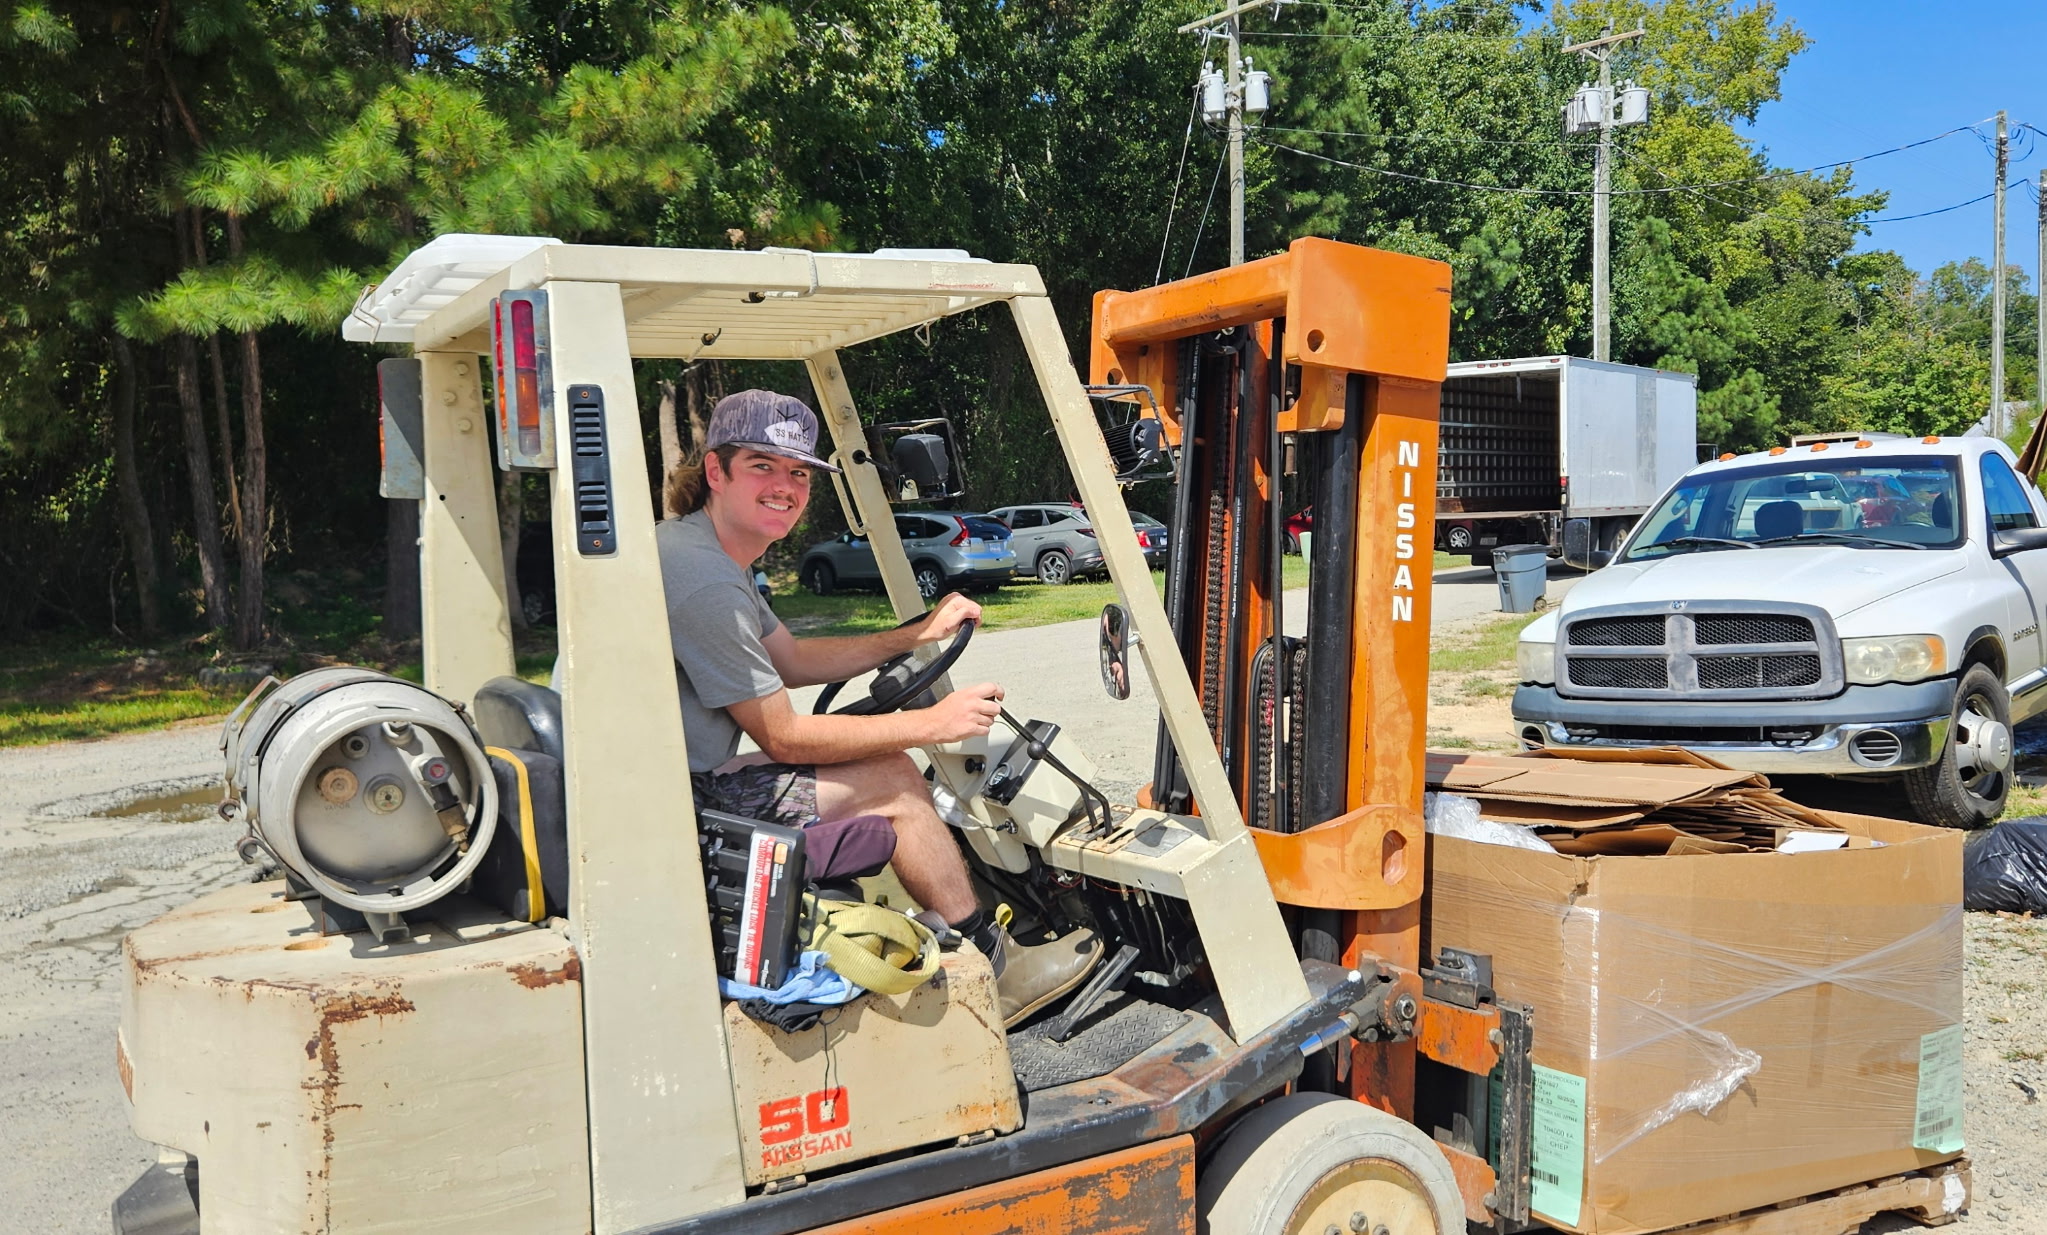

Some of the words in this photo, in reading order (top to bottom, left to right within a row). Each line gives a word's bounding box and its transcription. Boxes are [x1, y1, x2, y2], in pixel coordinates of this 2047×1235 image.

[787, 431, 802, 442] HAT
[1391, 439, 1420, 622] NISSAN
[759, 1087, 848, 1146] 50
[761, 1131, 852, 1169] NISSAN
[1550, 1140, 1569, 1151] CHEP
